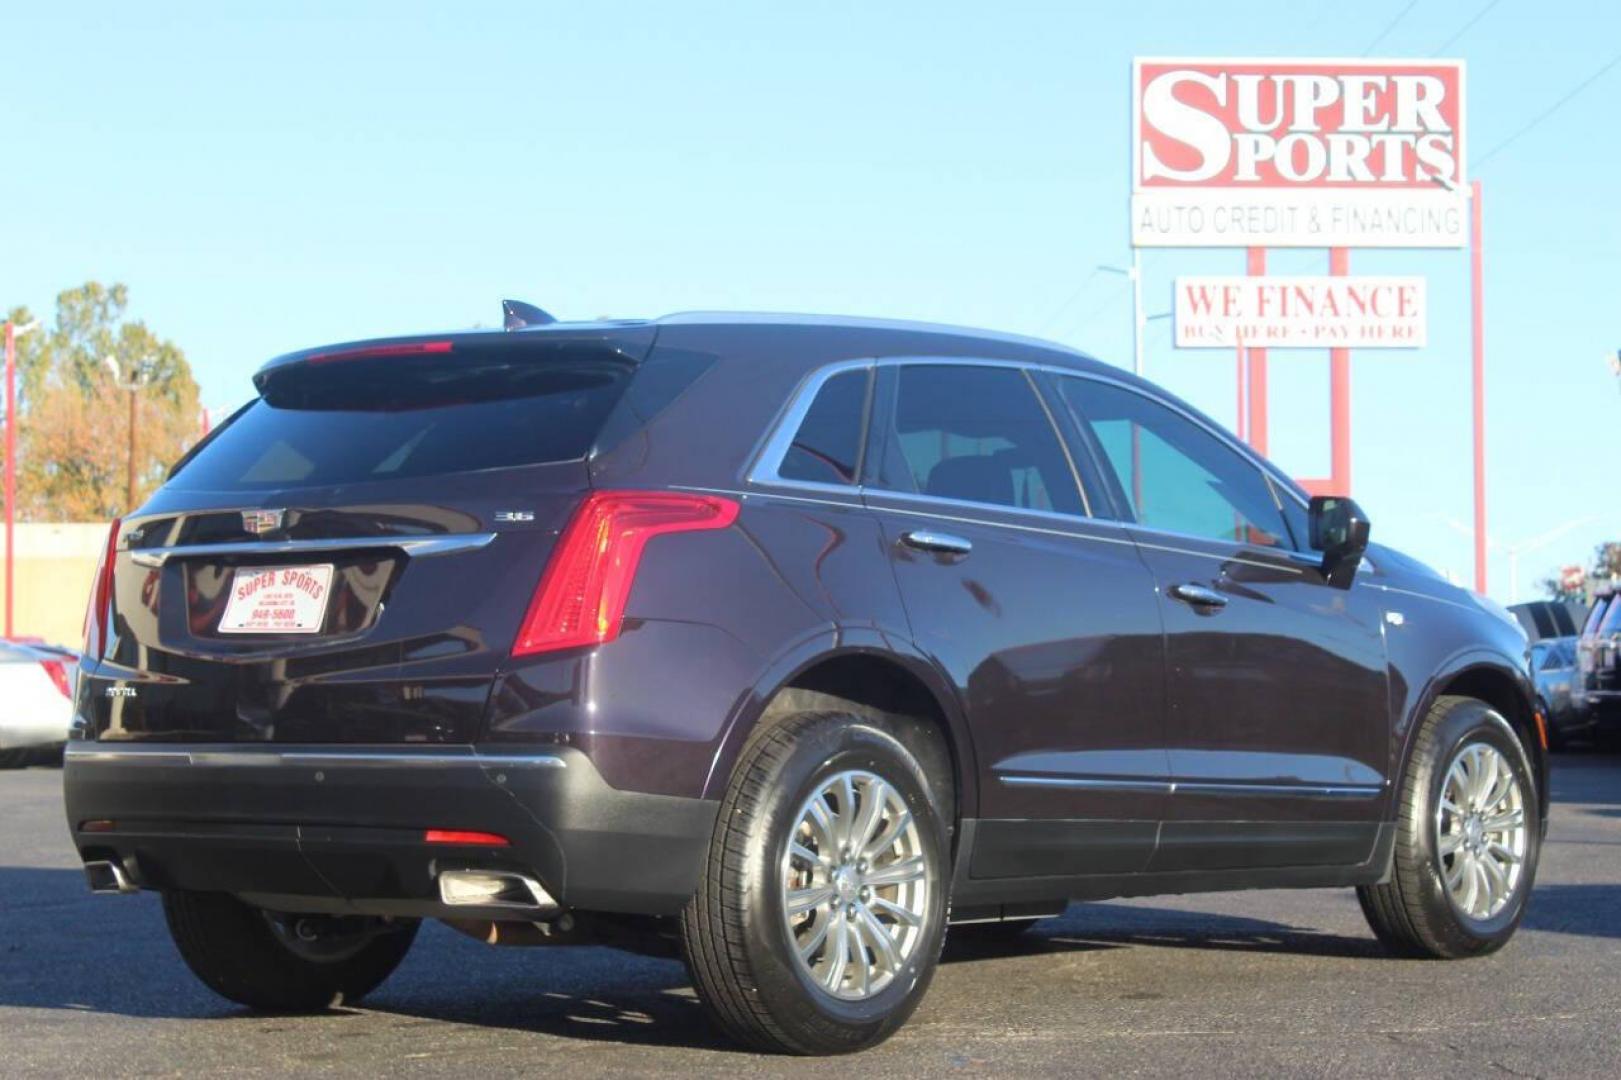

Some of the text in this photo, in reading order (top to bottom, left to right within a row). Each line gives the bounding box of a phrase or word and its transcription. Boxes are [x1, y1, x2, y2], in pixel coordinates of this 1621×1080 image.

[1141, 207, 1460, 234] AUTO CREDIT & FINANCING
[1185, 285, 1418, 318] WE FINANCE
[1314, 325, 1348, 339] PAY
[1361, 325, 1416, 339] HERE
[238, 569, 324, 600] SUPER SPORTS
